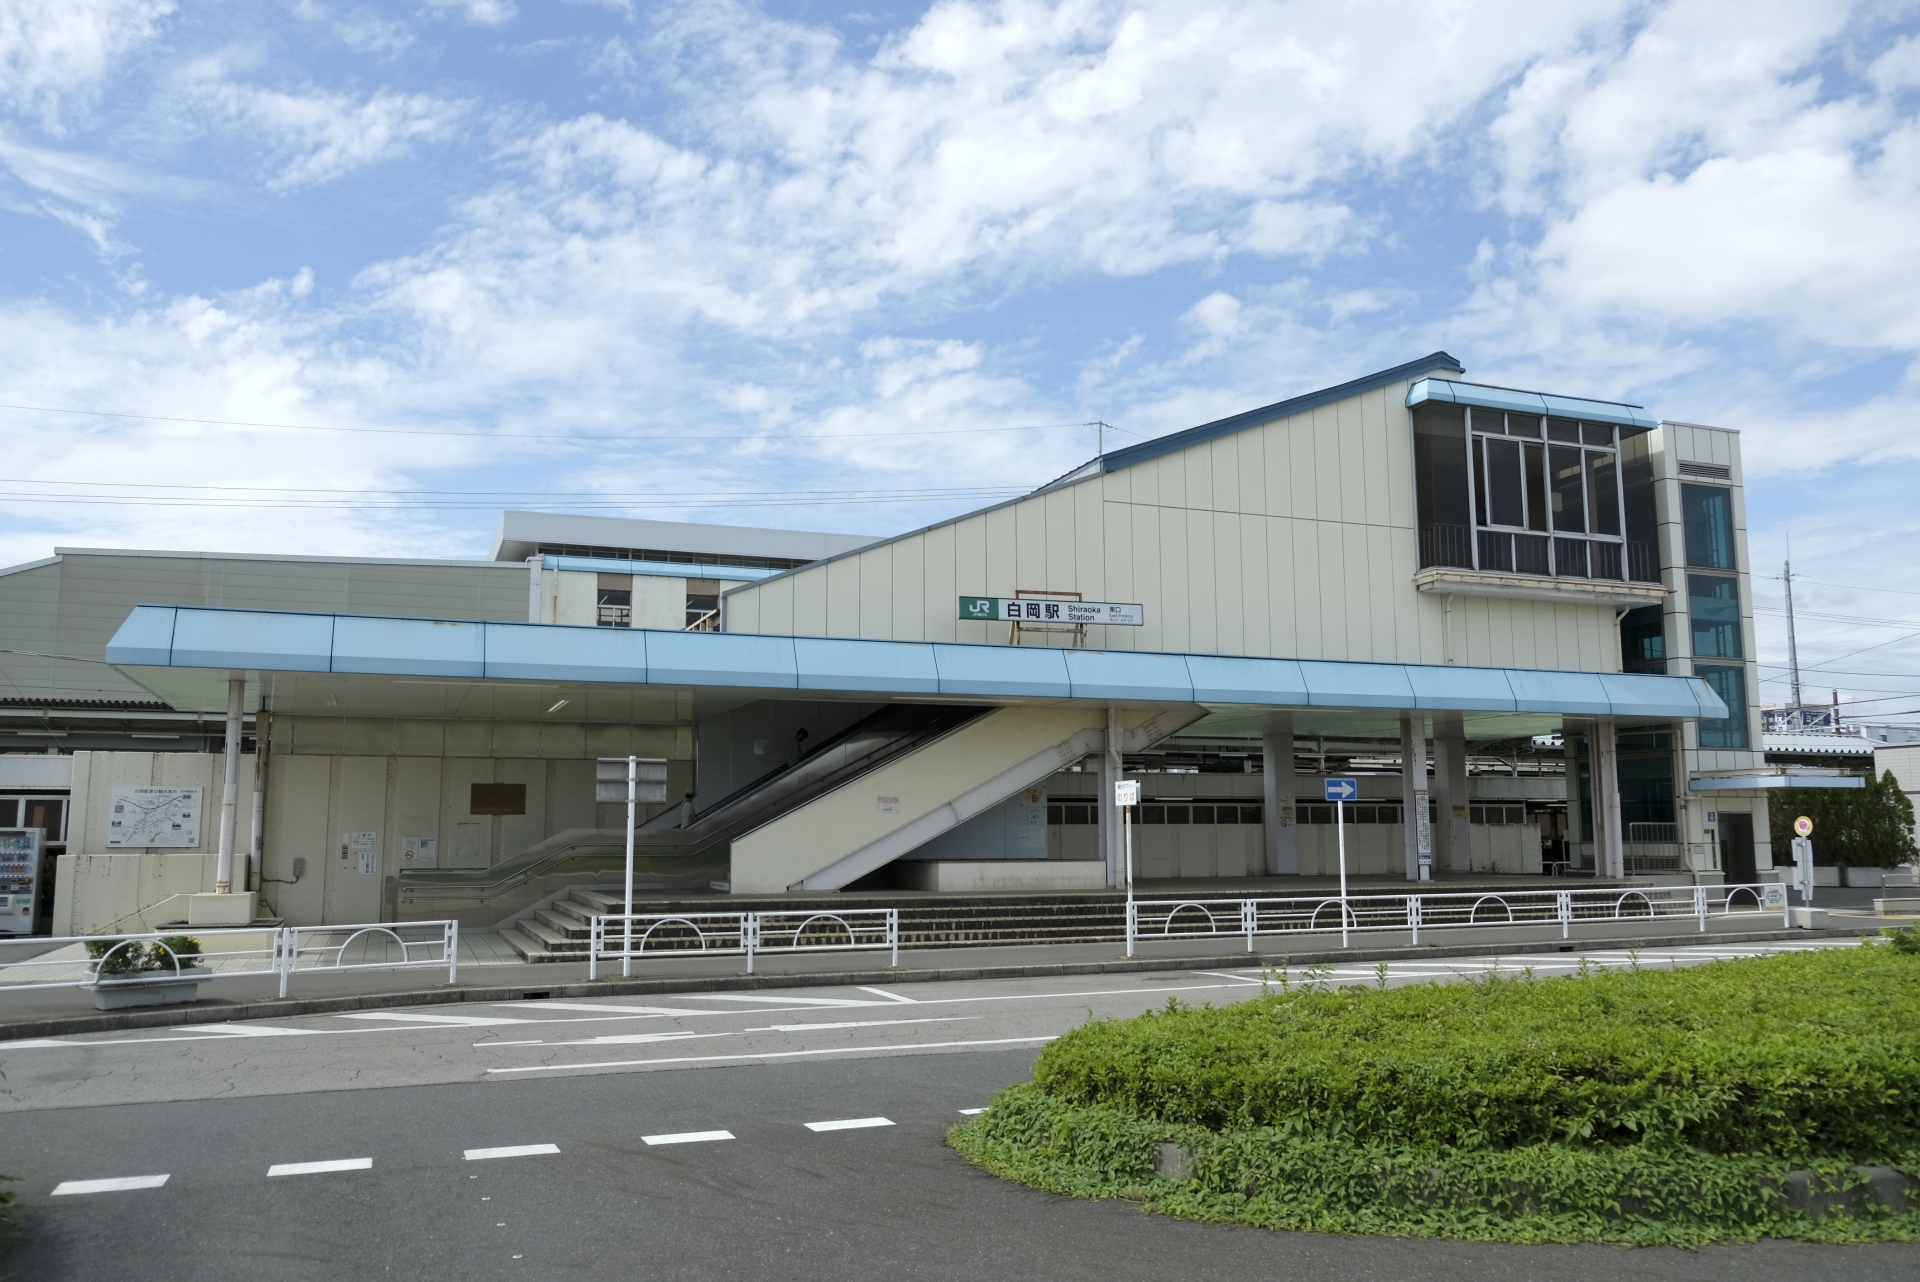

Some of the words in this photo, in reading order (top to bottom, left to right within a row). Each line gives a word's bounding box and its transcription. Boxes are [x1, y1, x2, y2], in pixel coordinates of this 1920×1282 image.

[969, 600, 990, 613] JR
[1007, 602, 1060, 619] 白岡駅
[1067, 604, 1101, 614] Shiraoka
[1068, 613, 1095, 621] Station
[1117, 792, 1135, 802] のりば
